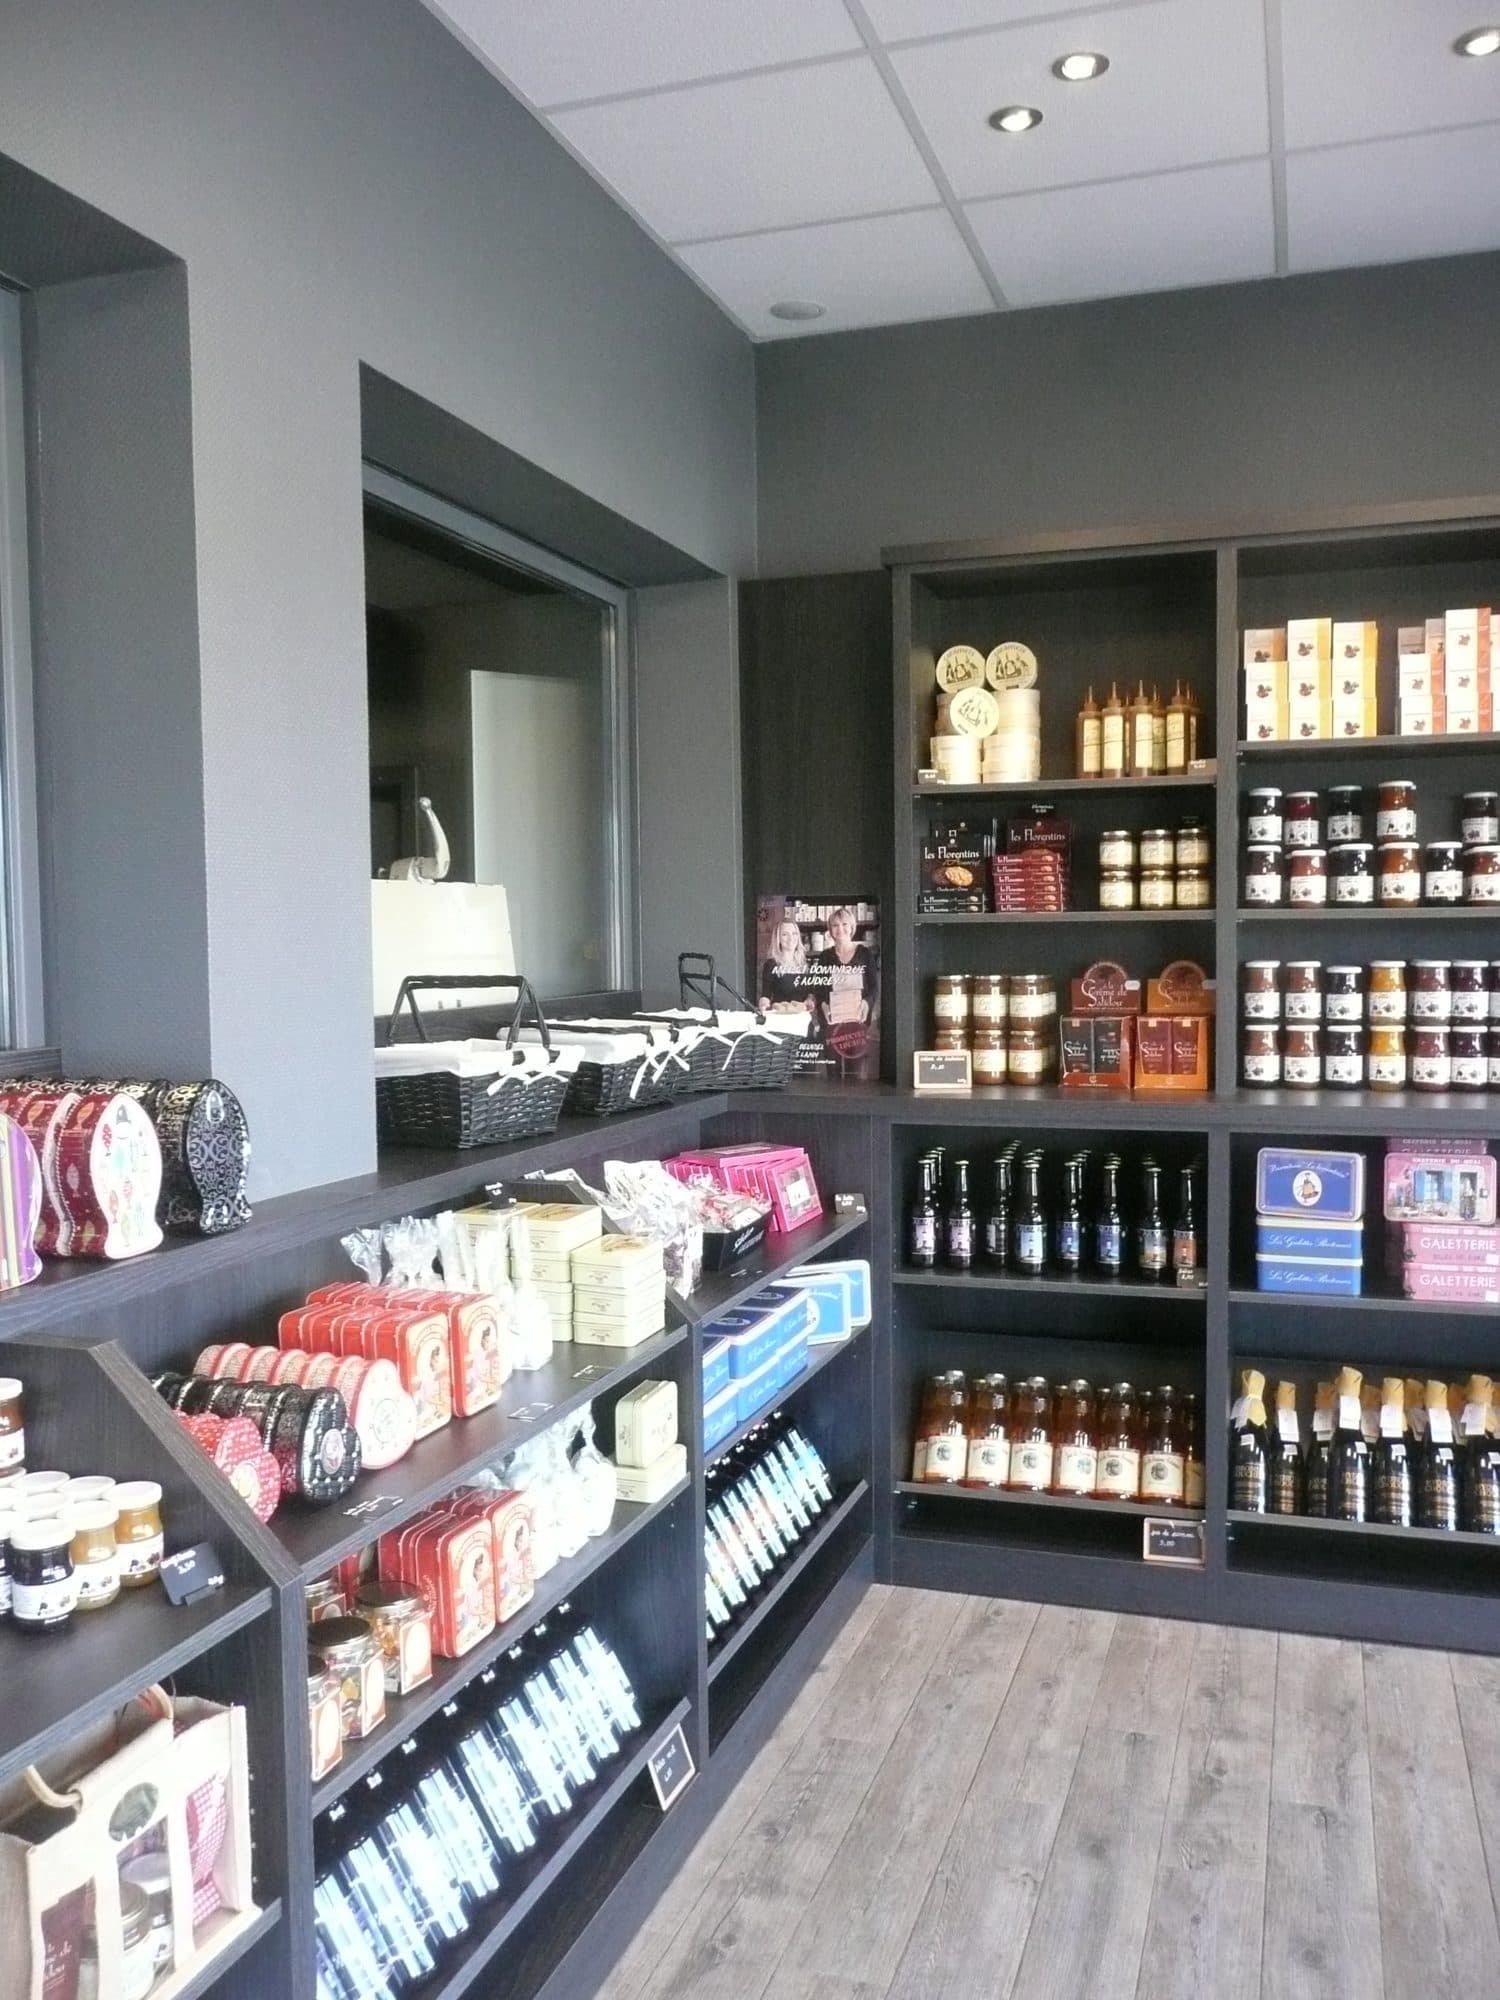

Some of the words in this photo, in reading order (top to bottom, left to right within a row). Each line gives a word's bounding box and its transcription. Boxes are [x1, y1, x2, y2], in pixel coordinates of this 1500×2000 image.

[1024, 829, 1066, 841] Florentins
[938, 846, 980, 862] Florentins
[810, 964, 867, 974] DOMINIQUE
[1420, 1237, 1496, 1251] GALETTERIE
[1419, 1274, 1496, 1288] GALETTERIE
